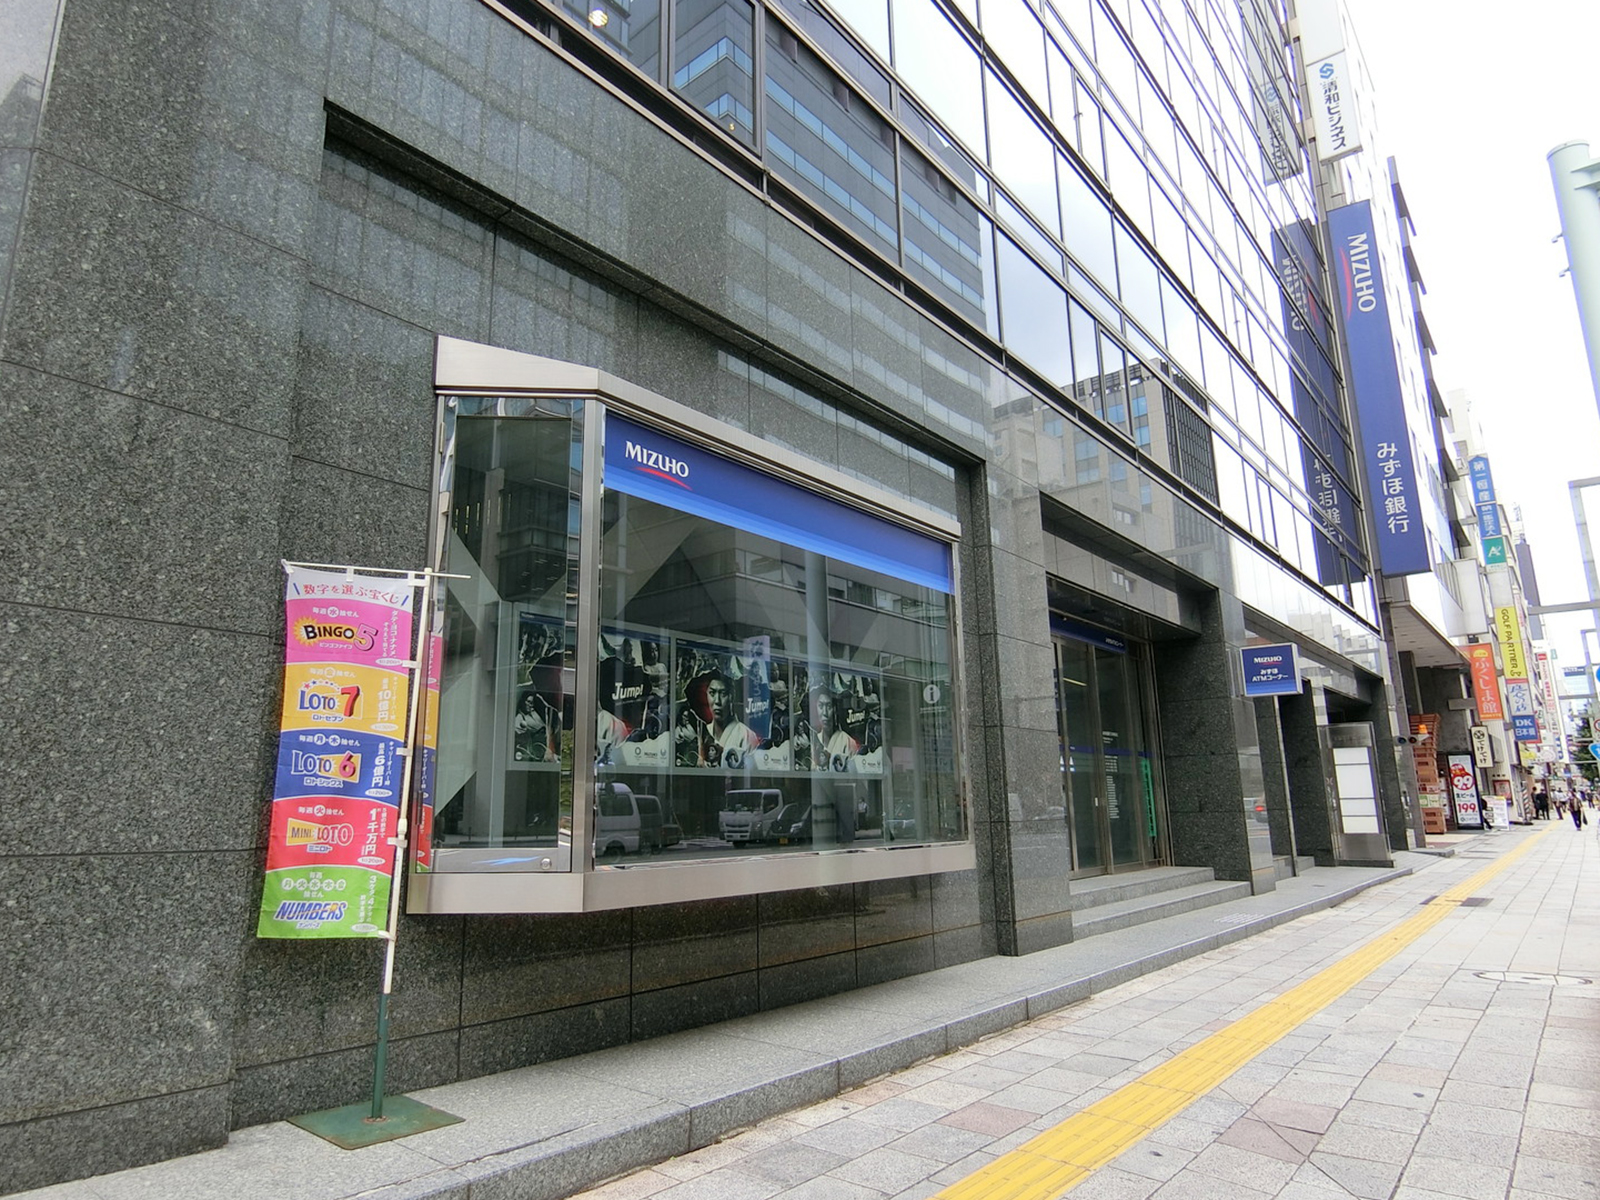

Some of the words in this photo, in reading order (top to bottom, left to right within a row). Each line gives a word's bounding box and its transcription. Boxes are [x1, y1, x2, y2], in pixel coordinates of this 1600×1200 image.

[1348, 231, 1377, 313] MIZUHO
[625, 440, 690, 478] MIZUHO
[1377, 442, 1410, 535] みずほ銀行
[303, 583, 400, 605] 数字を選ぶ宝くじ
[1501, 608, 1512, 629] GOLF
[1505, 630, 1518, 669] PARTNER
[611, 682, 644, 700] Jump!
[1475, 657, 1498, 713] ふくしま館
[299, 690, 336, 711] LOTO
[340, 685, 360, 717] 7
[745, 697, 770, 714] Jump!
[312, 714, 344, 723] ロトセブン
[846, 708, 867, 724] Jump!
[1515, 718, 1533, 727] DK
[291, 750, 333, 775] LOTO
[338, 751, 357, 779] 6
[303, 776, 344, 787] ロトシックス
[290, 825, 312, 838] MINI
[316, 823, 354, 846] LOTO
[274, 901, 348, 921] NUMBERS
